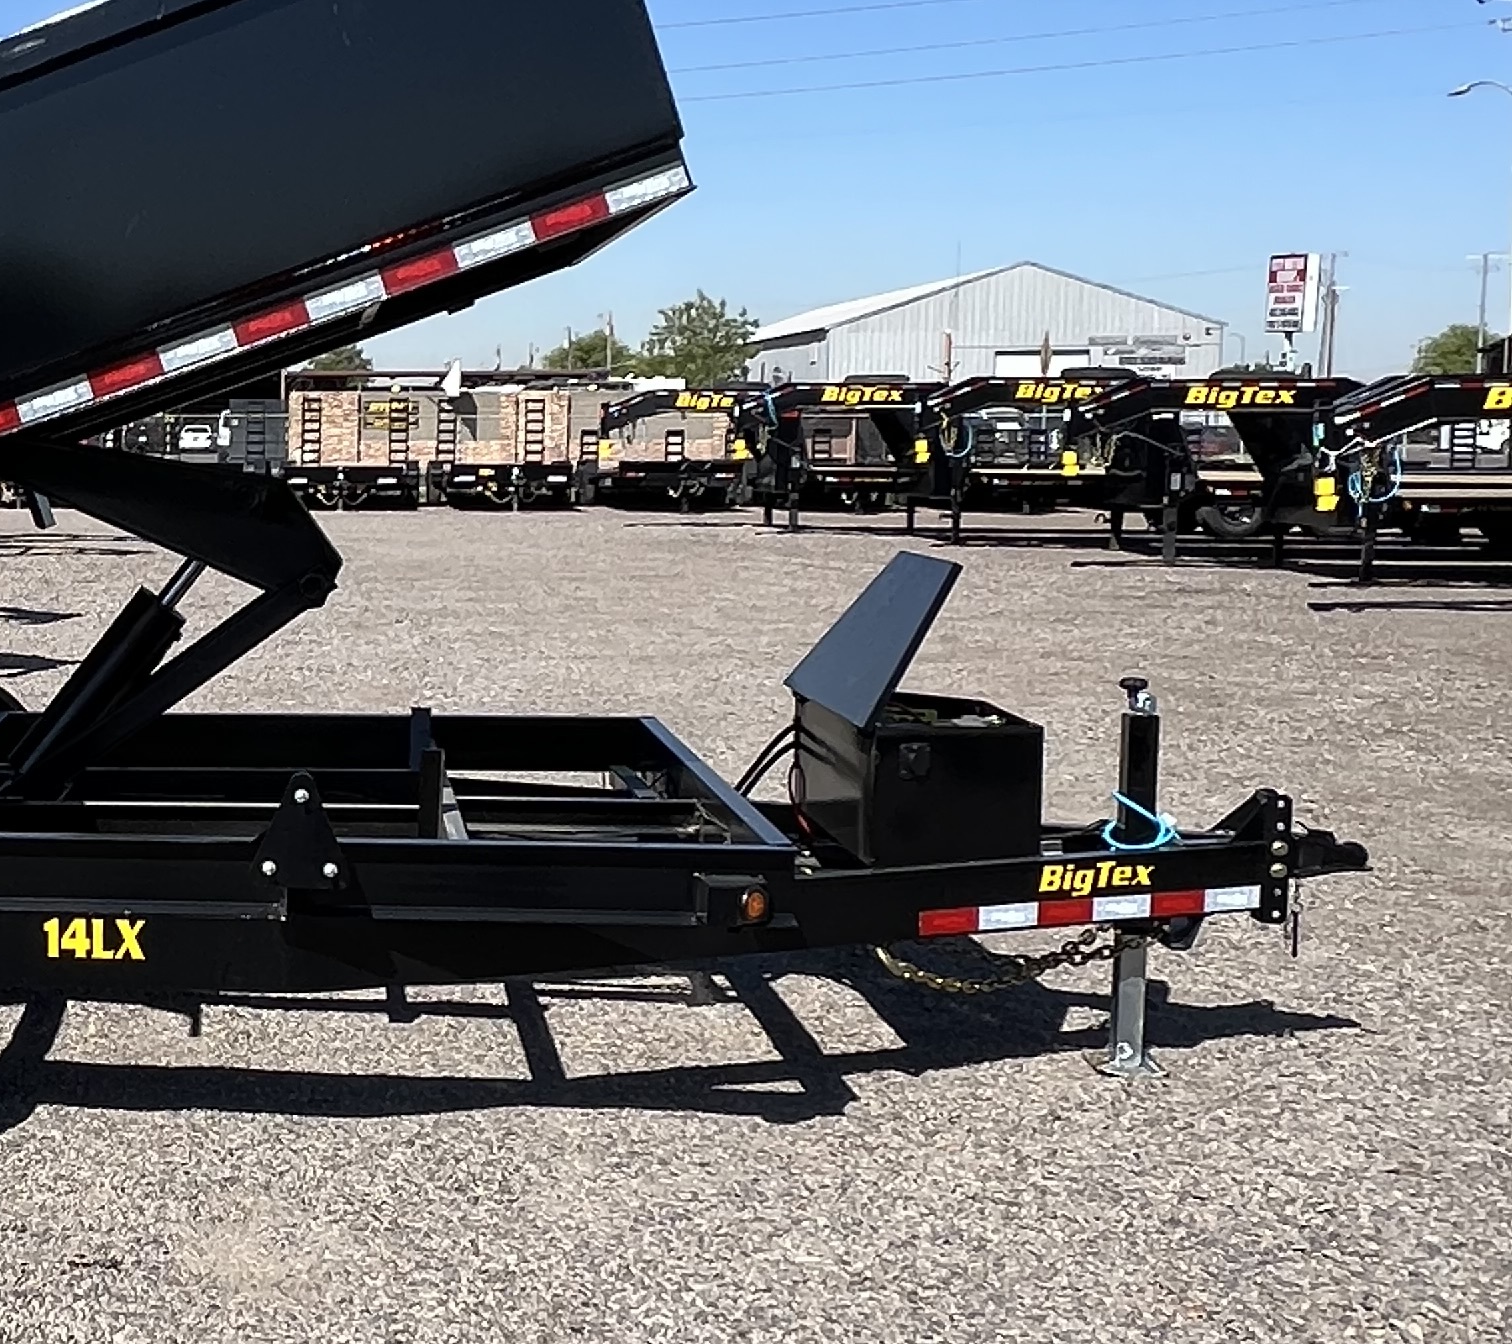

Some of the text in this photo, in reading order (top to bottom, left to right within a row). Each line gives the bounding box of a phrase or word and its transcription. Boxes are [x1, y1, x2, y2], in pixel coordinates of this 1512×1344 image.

[675, 392, 734, 410] BigTe
[821, 386, 903, 405] BigTex
[1184, 386, 1297, 408] BigTex
[1039, 861, 1155, 897] BigTex
[43, 917, 146, 960] 14LX
